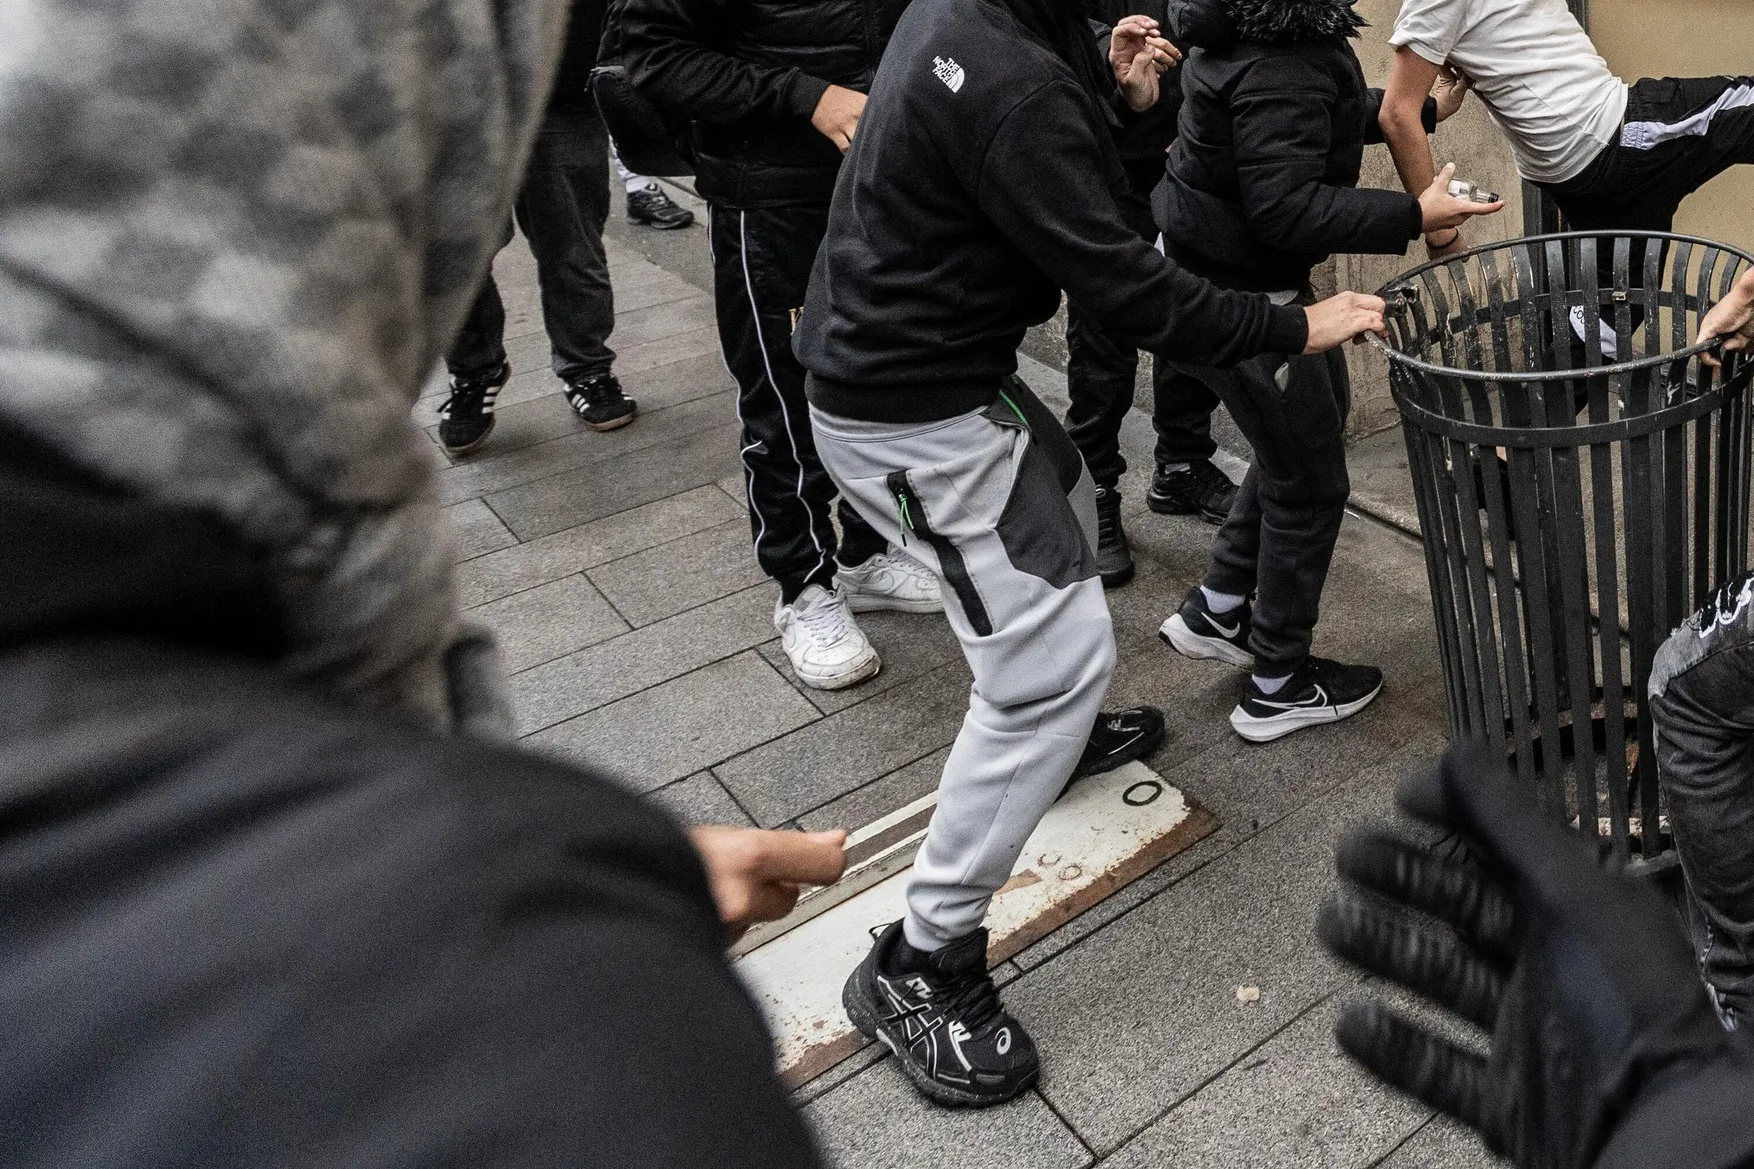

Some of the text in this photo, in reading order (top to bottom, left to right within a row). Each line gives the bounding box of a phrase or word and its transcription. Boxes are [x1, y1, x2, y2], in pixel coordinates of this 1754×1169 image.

[932, 55, 955, 79] NORTH
[946, 57, 961, 73] THE
[932, 67, 949, 83] FACE
